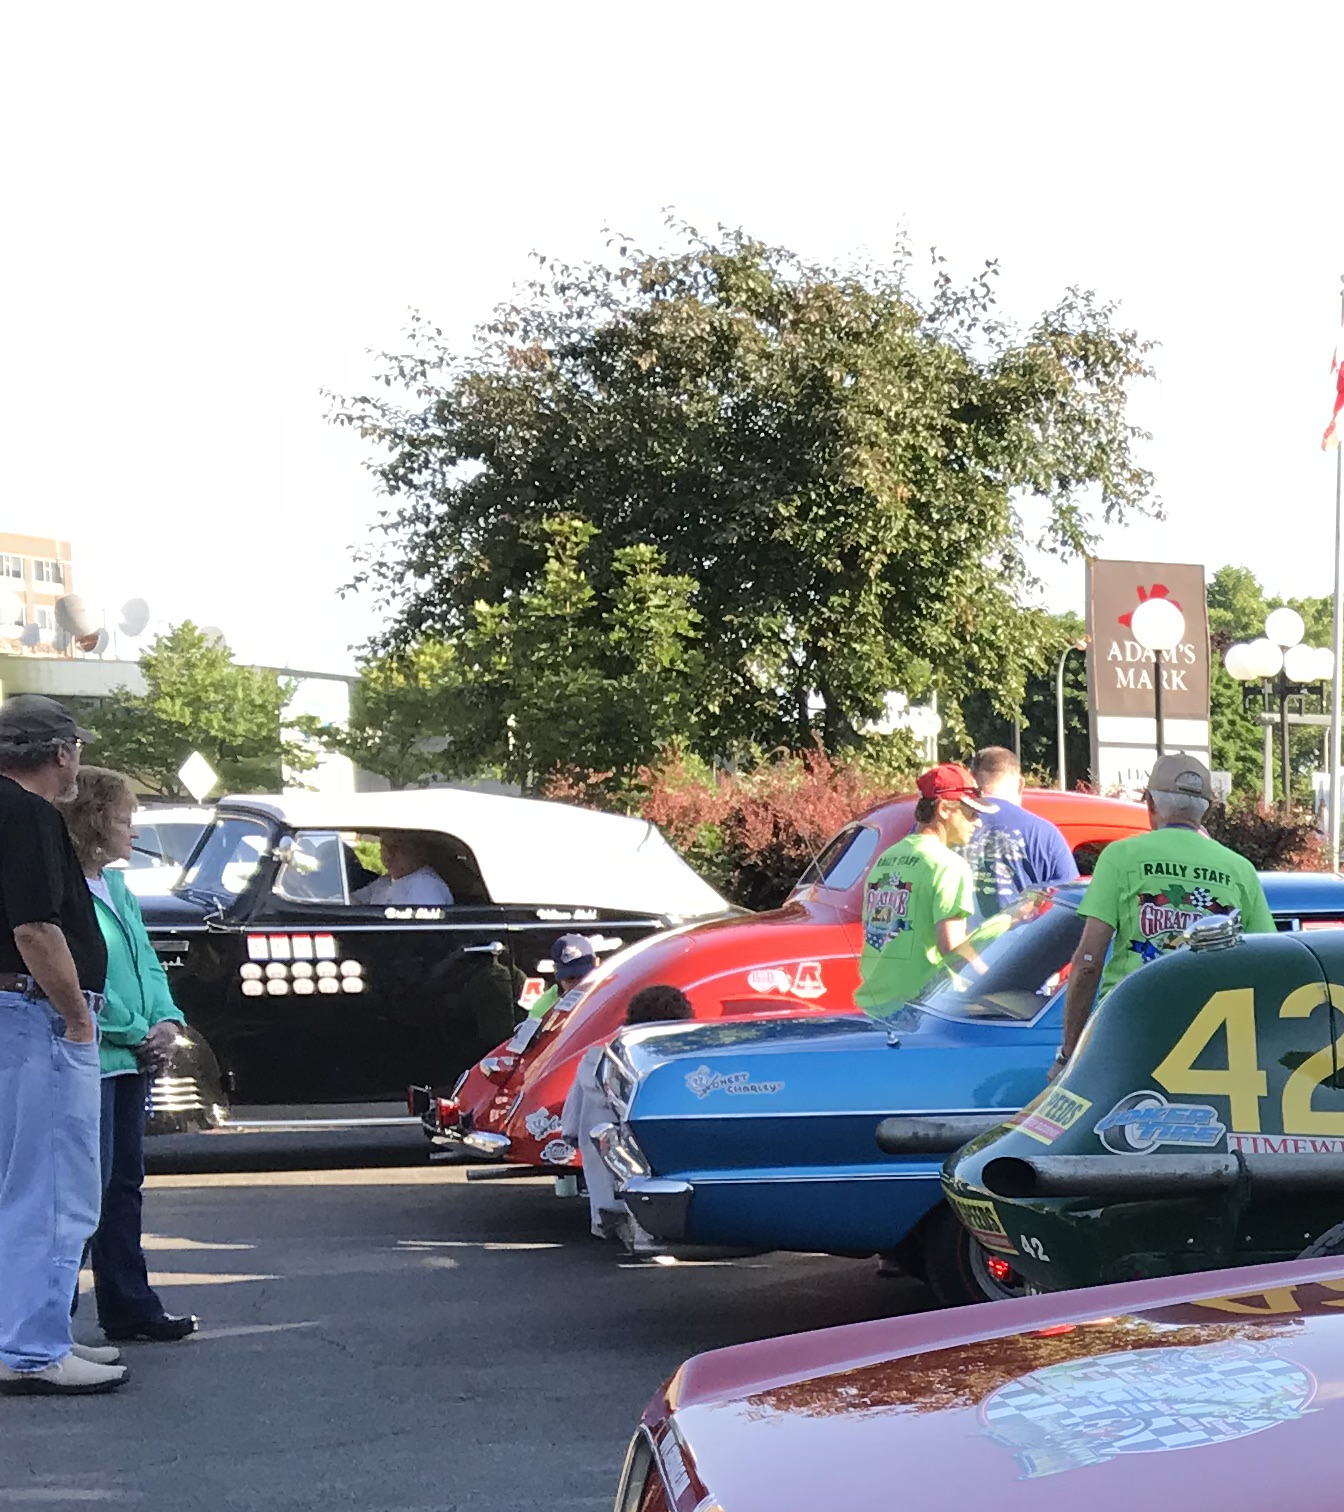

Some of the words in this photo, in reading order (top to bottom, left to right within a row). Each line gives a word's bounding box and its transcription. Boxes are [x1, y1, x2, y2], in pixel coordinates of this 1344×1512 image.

[1144, 863, 1188, 878] RALLY
[1193, 867, 1231, 886] STAFF
[1140, 903, 1193, 938] GREAT
[1139, 1125, 1224, 1143] TIRE
[1020, 1234, 1050, 1262] 42
